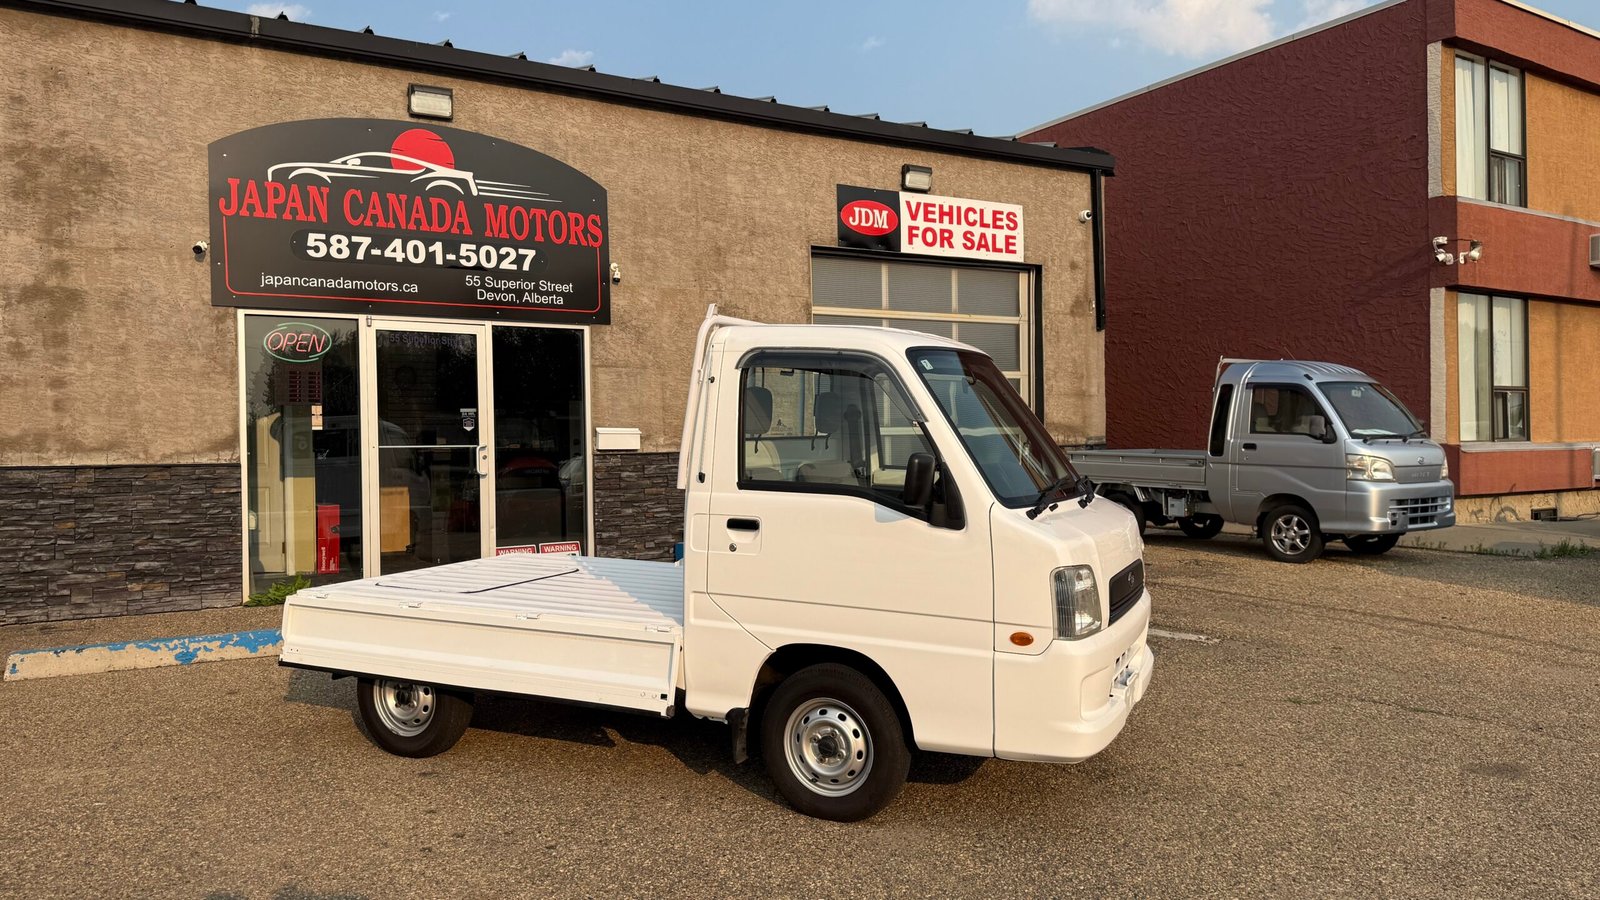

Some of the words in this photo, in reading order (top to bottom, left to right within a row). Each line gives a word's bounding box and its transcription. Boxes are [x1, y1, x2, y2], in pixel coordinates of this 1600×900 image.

[219, 177, 330, 223] JAPAN
[343, 189, 473, 235] CANADA
[484, 203, 603, 248] MOTORS
[849, 206, 889, 229] JDM
[905, 200, 1019, 231] VEHICLES
[907, 225, 955, 249] FOR
[962, 230, 1017, 254] SALE
[306, 232, 536, 272] 587-401-5027
[260, 272, 419, 293] japancanadamotors.ca
[465, 274, 481, 287] 55
[484, 276, 535, 291] Superior
[538, 280, 574, 293] Street
[476, 288, 520, 304] Devon,
[522, 292, 564, 305] Alberta
[267, 332, 326, 352] OPEN
[543, 543, 577, 553] WARNING
